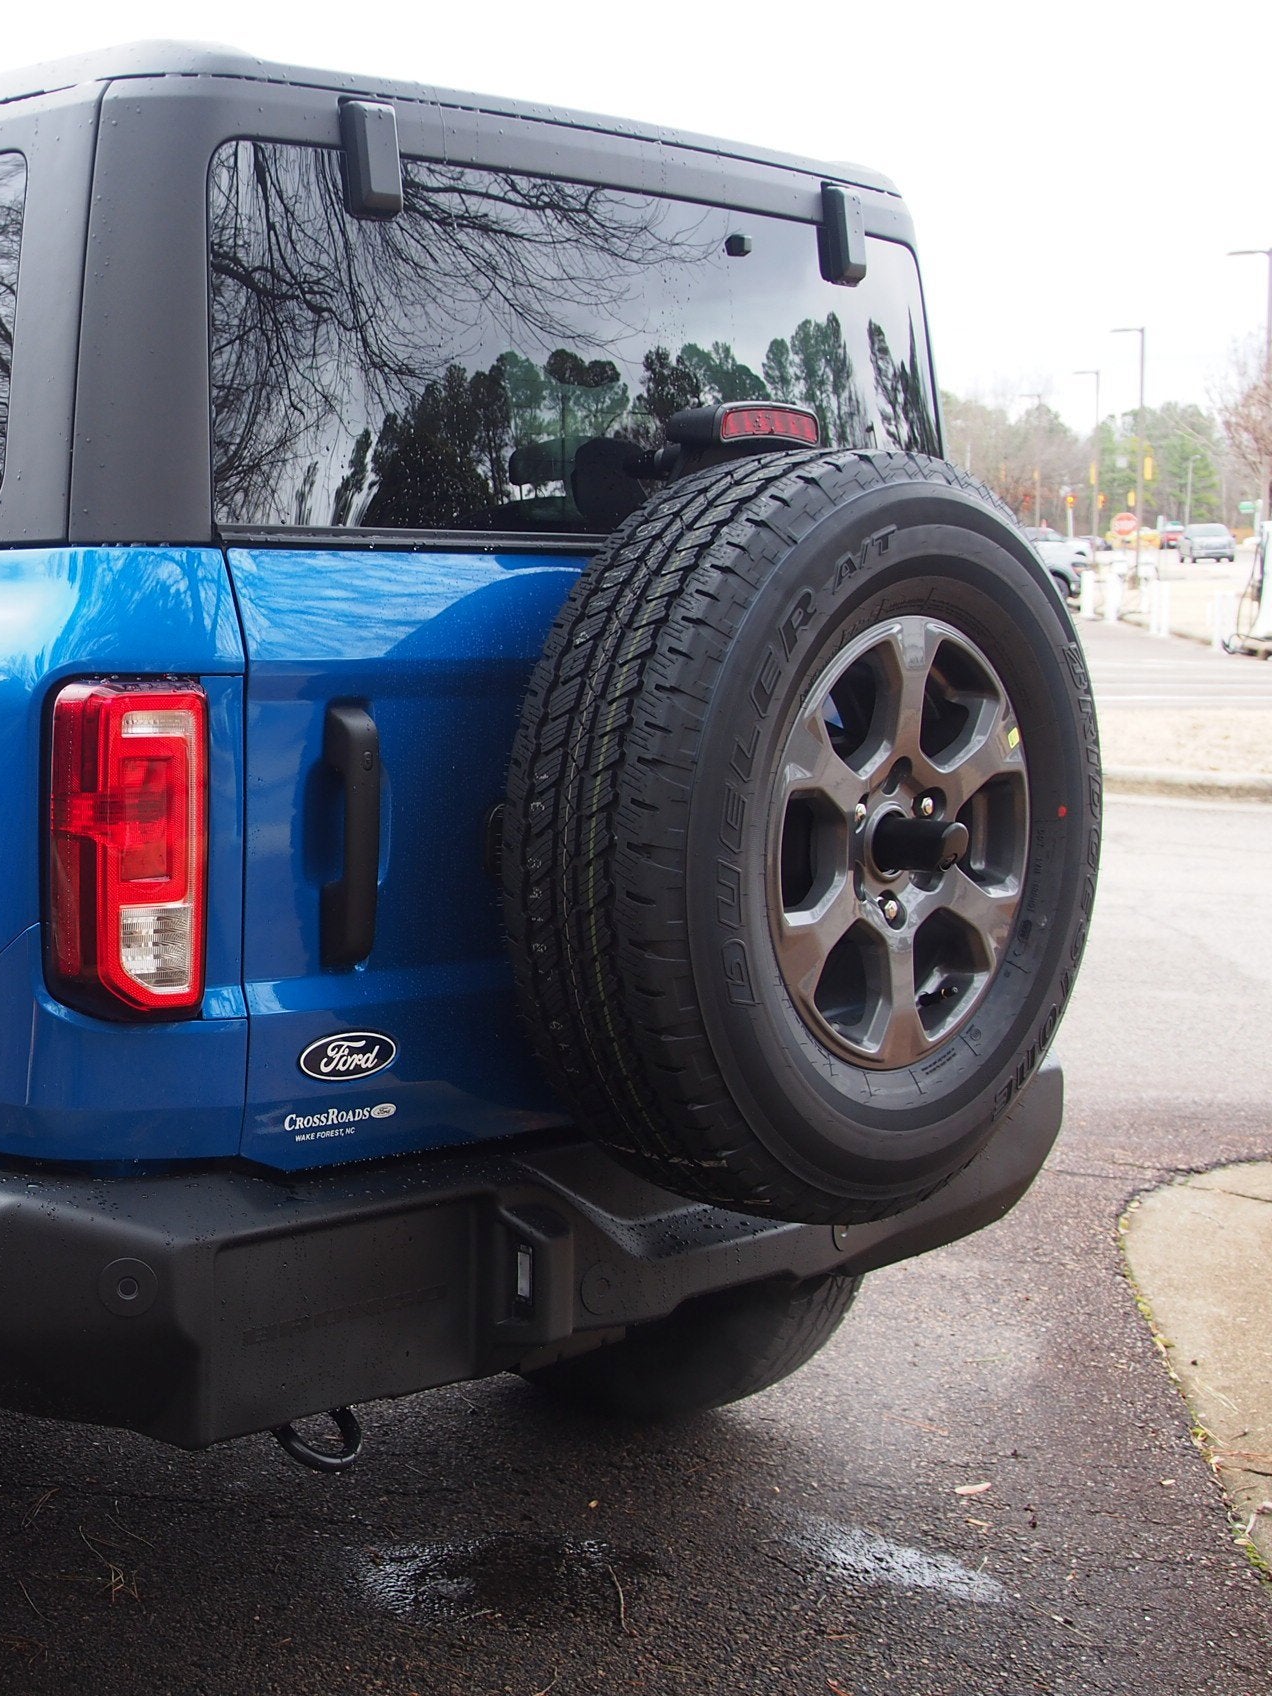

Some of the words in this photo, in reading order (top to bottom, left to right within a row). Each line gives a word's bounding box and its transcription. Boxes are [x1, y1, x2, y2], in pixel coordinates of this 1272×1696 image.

[717, 585, 817, 1008] DUELER
[833, 524, 899, 595] A/T
[320, 1040, 380, 1073] Ford
[295, 1132, 316, 1142] WAKE
[316, 1129, 345, 1139] FOREST,
[345, 1126, 356, 1135] NC
